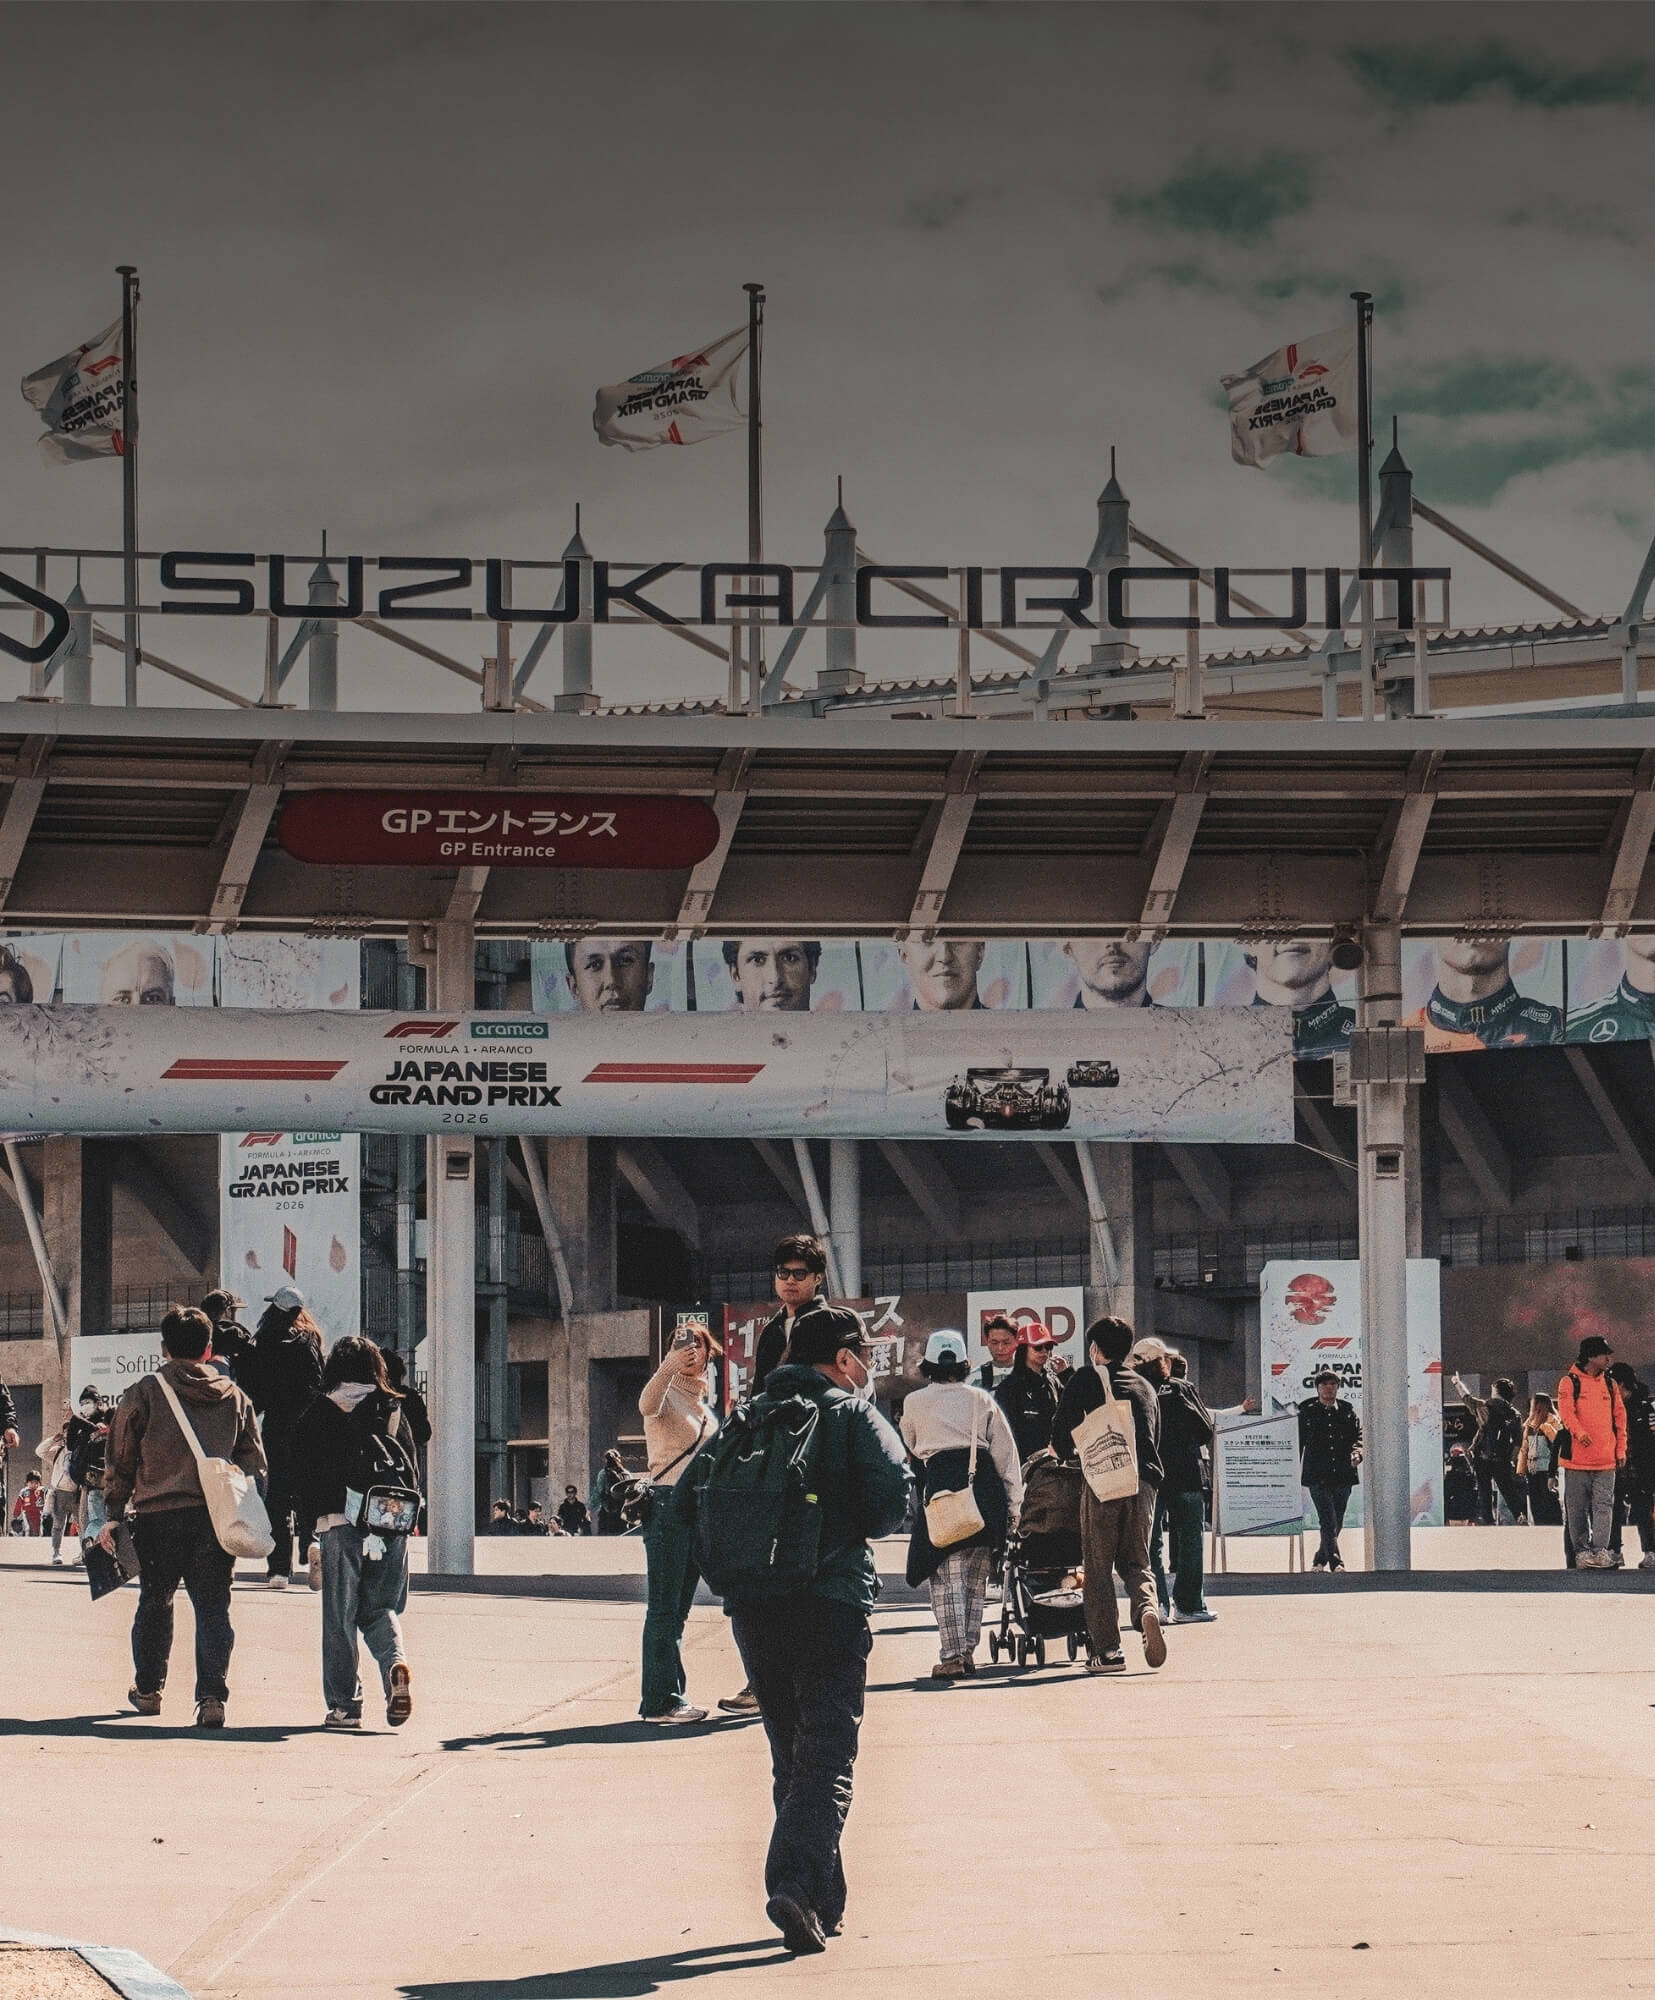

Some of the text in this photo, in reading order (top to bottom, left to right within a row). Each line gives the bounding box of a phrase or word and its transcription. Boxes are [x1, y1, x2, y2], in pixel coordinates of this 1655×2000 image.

[160, 551, 1451, 631] SUZUKA CIRCUIT
[381, 809, 619, 838] GPエントランス
[440, 842, 556, 858] GP Entrance
[475, 1023, 545, 1036] aramco
[400, 1045, 533, 1054] FORMULA 1 ARAMCO
[386, 1060, 547, 1082] JAPANESE
[369, 1084, 562, 1106] GRAND PRIX
[442, 1113, 489, 1124] 2026
[247, 1151, 285, 1160] FORMULA
[239, 1160, 340, 1180] JAPANESE
[229, 1177, 350, 1198] GRAND PRIX
[275, 1201, 305, 1211] 2026
[680, 1315, 706, 1324] TAG
[1310, 1363, 1362, 1376] JAPAN
